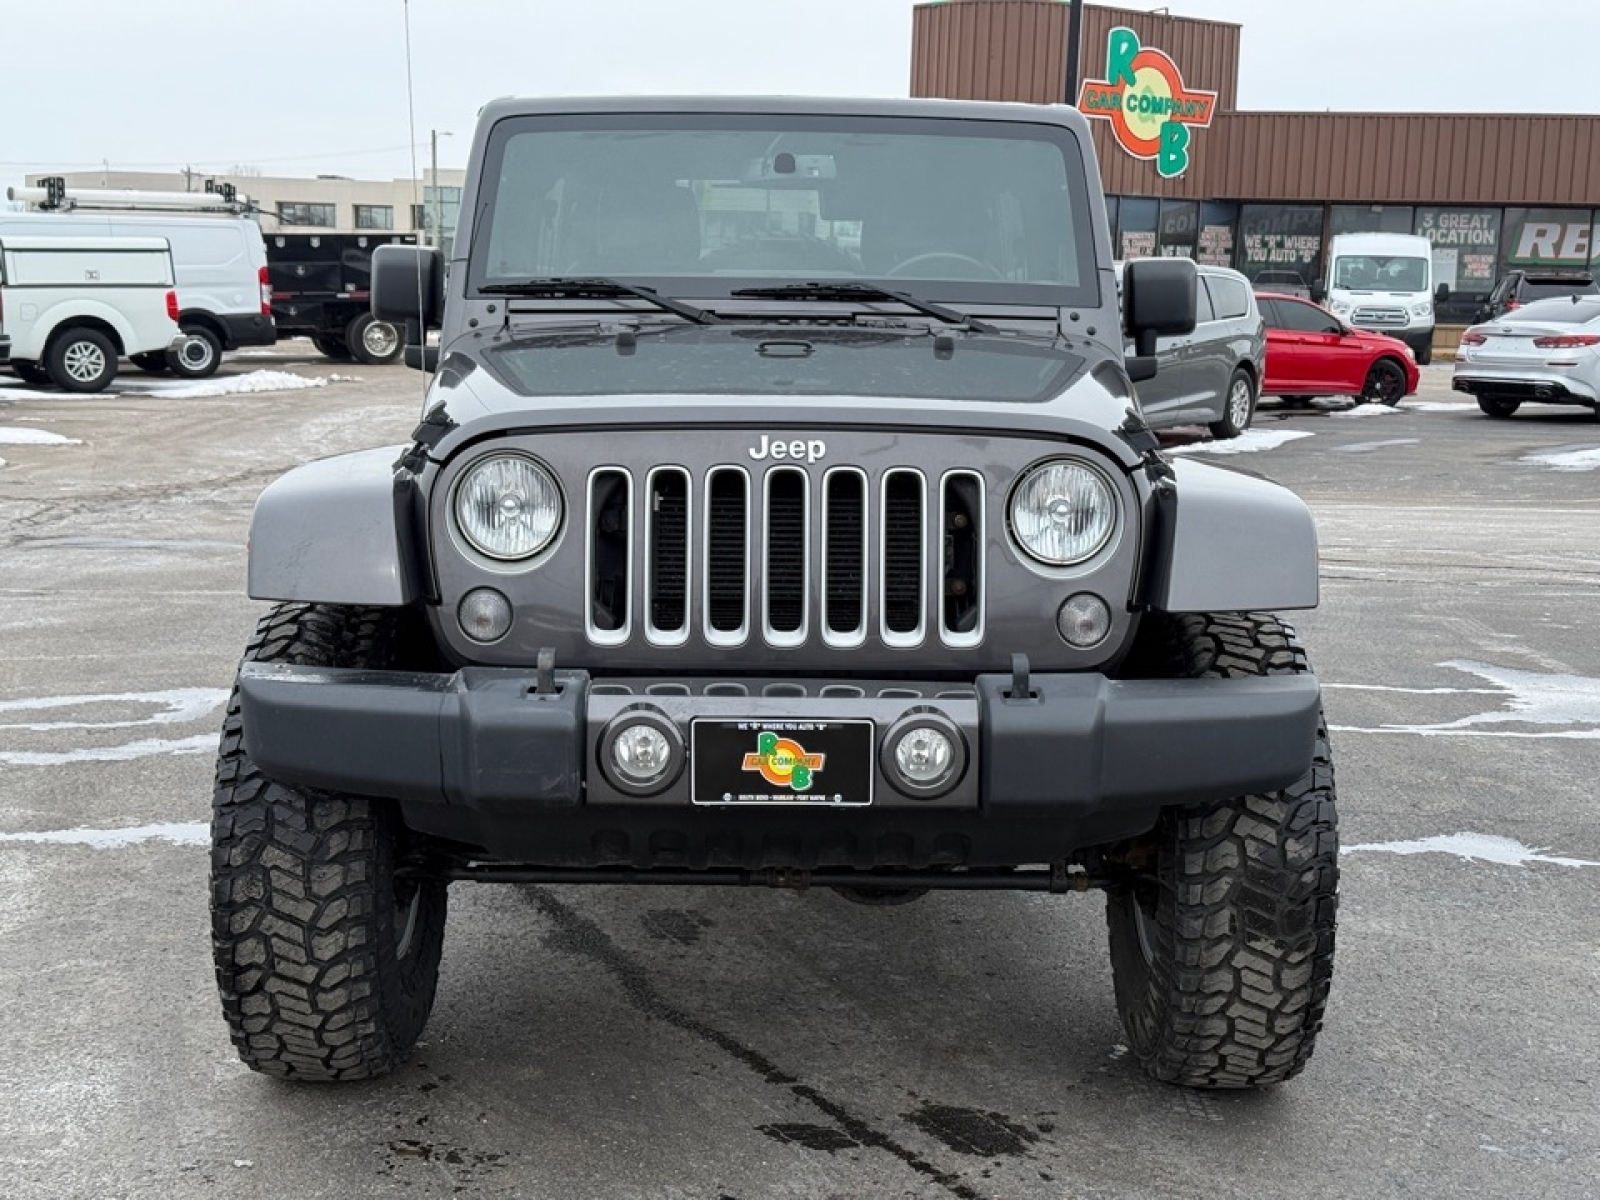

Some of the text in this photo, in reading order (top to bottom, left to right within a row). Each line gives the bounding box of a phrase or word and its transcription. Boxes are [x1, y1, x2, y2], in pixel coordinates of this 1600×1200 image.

[1107, 27, 1140, 87] R
[1085, 89, 1208, 117] CAR COMPANY
[1157, 120, 1190, 178] B
[1423, 213, 1491, 229] 3 GREAT
[1245, 234, 1262, 248] WE
[1284, 235, 1320, 249] WHERE
[1247, 248, 1267, 262] YOU
[1270, 249, 1296, 262] AUTO
[749, 434, 826, 463] Jeep
[758, 732, 778, 756] R
[791, 764, 813, 790] B
